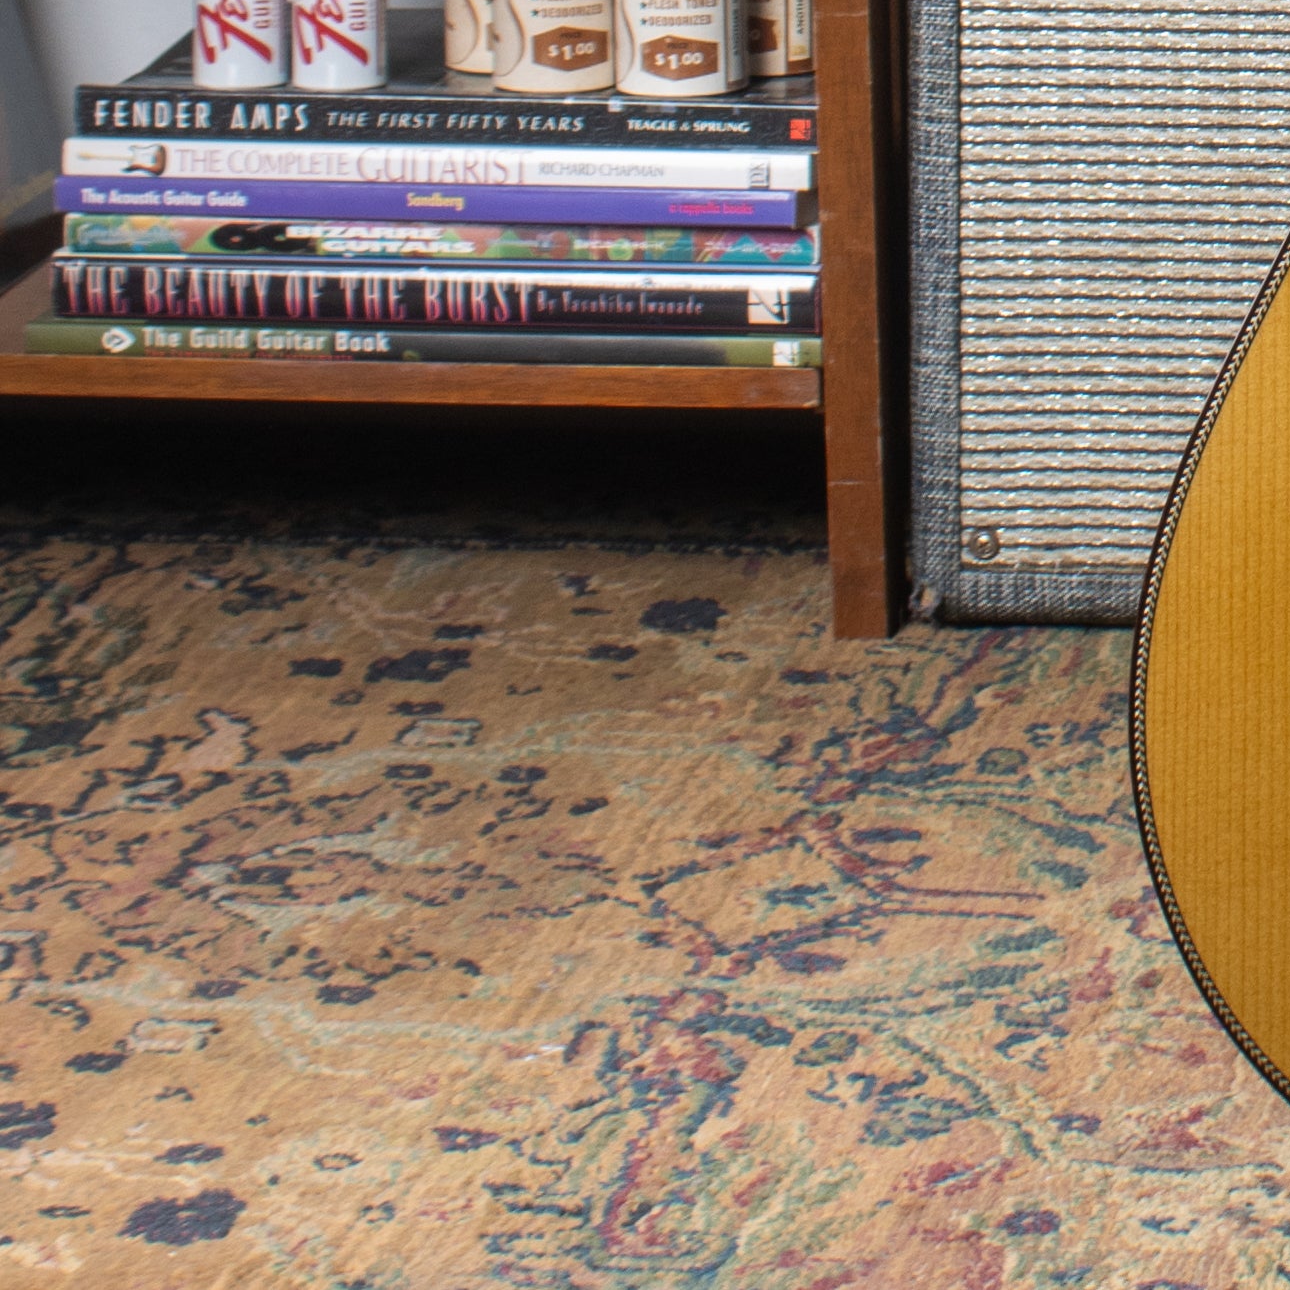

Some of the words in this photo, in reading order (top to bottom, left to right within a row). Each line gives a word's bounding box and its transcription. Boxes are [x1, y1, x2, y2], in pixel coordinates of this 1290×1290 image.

[94, 100, 212, 129] FENDER
[230, 103, 309, 131] AMPS
[327, 111, 370, 128] THE
[377, 112, 439, 128] FIRST
[446, 114, 508, 130] FIFTY
[517, 115, 584, 132] YEARS
[176, 149, 223, 173] THE
[227, 149, 350, 176] COMPLETE
[355, 147, 532, 186] GUITARIST
[81, 188, 106, 205] The
[109, 189, 160, 205] Acoustic
[163, 190, 204, 207] Guitar
[207, 191, 248, 207] Guide
[406, 192, 466, 211] Sandberg
[62, 267, 129, 315] THE
[143, 267, 272, 318] BEAUTY
[284, 270, 326, 319] OF
[339, 270, 408, 320] THE
[424, 278, 532, 323] BURST
[143, 327, 182, 348] The
[189, 328, 249, 350] Guild
[256, 330, 329, 351] Guitar
[334, 331, 390, 353] Book
